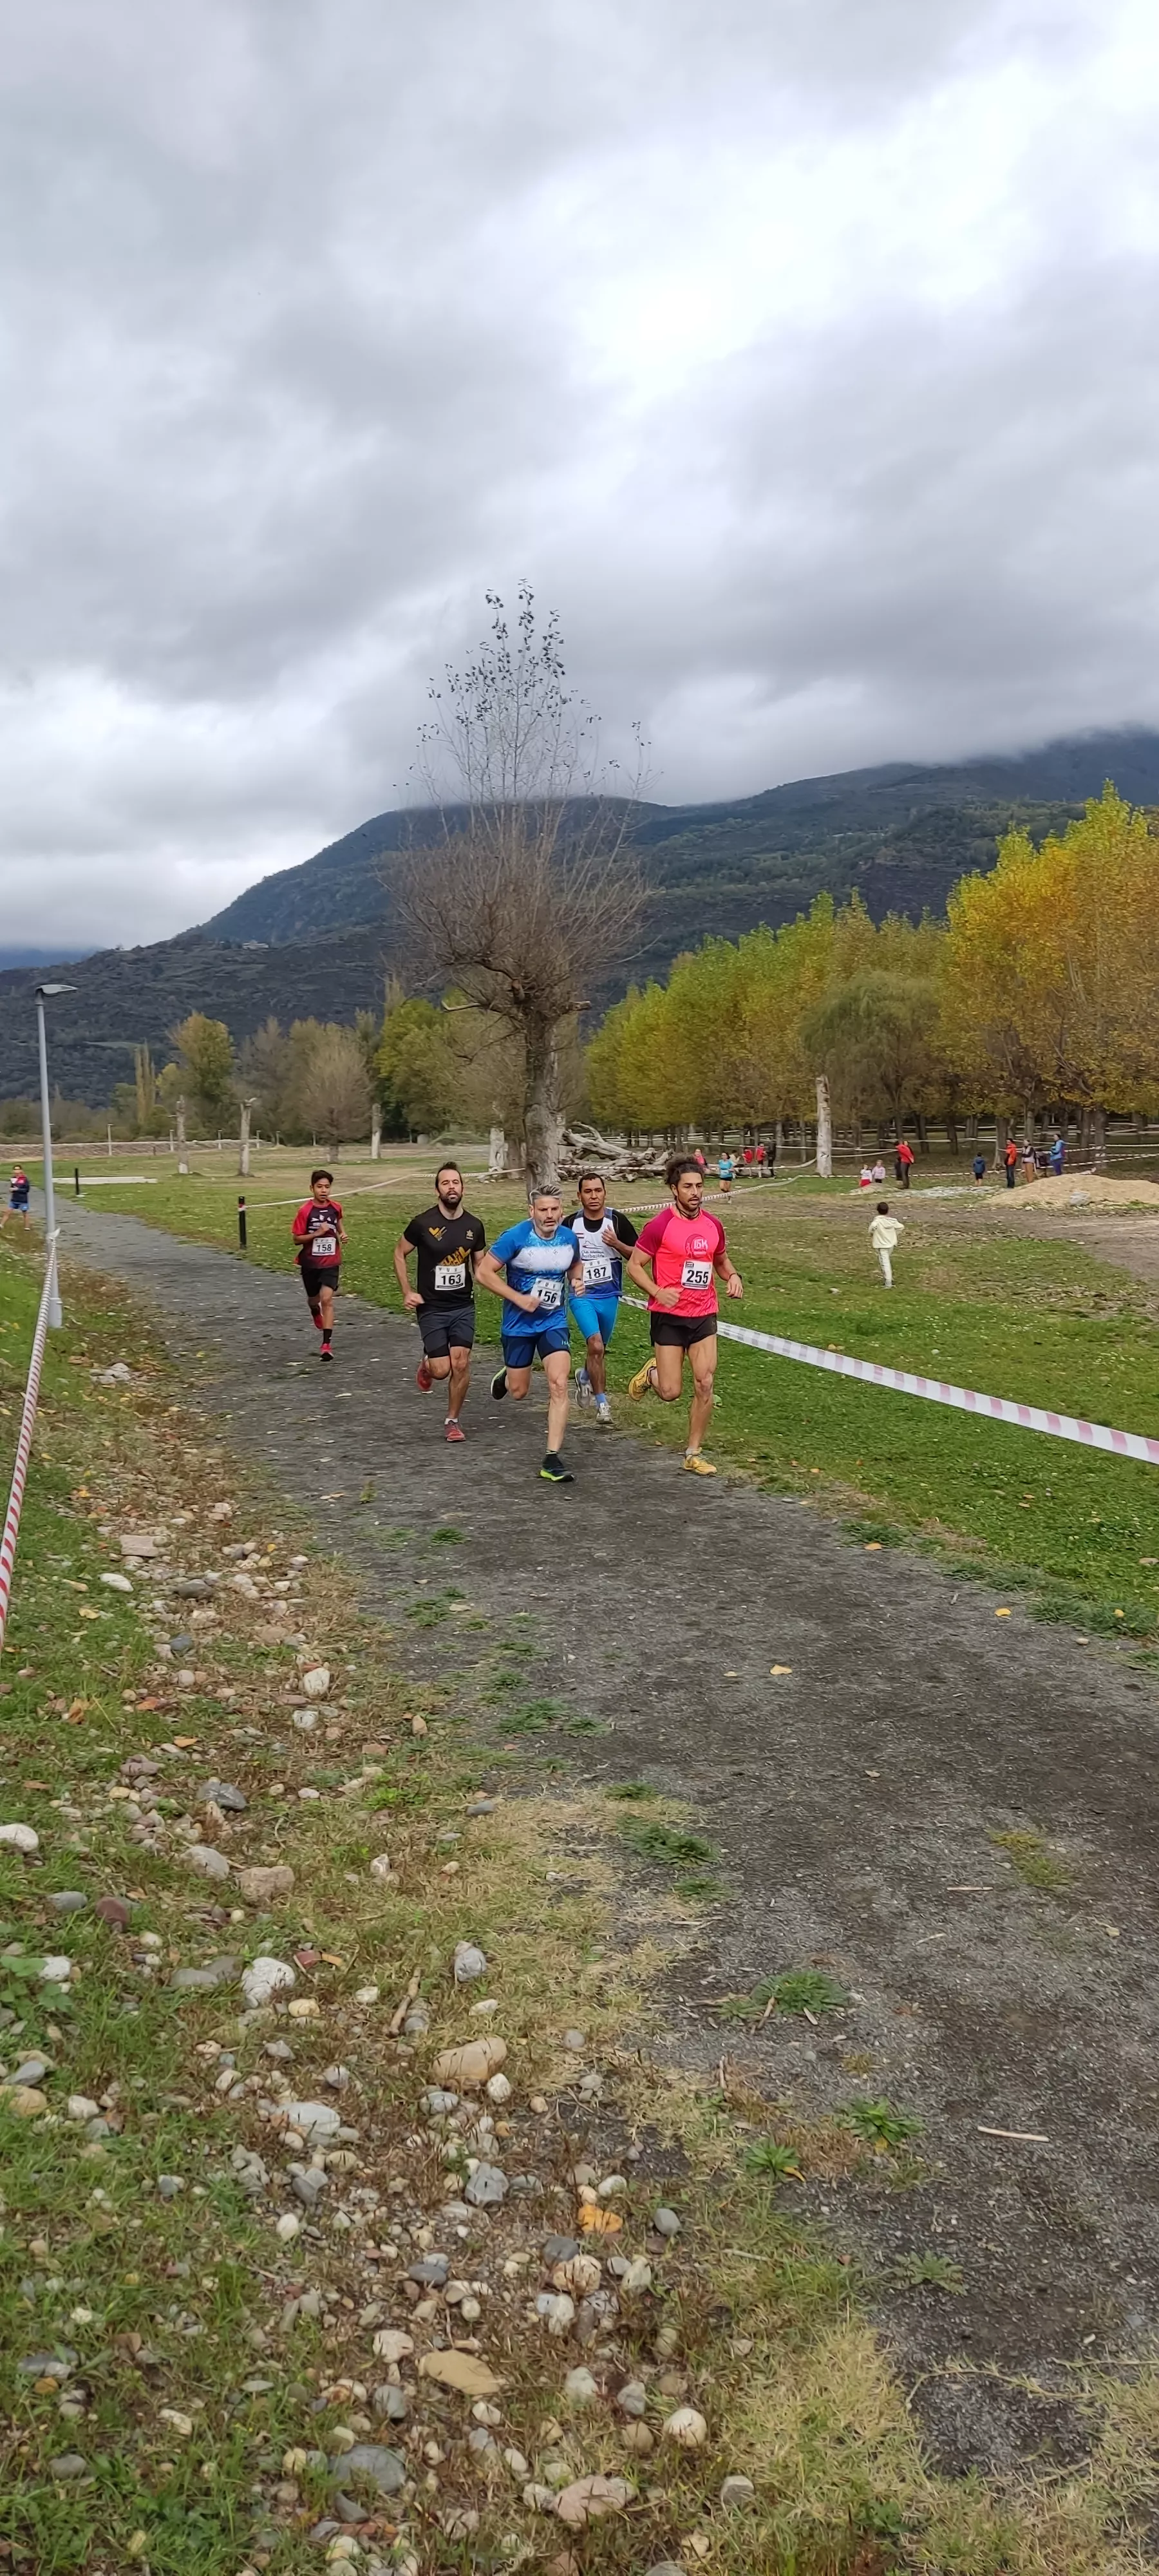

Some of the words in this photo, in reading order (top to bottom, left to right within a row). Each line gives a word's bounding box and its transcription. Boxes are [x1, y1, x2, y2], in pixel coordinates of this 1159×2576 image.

[316, 1244, 332, 1252] 158
[440, 1274, 462, 1285] 163
[586, 1266, 607, 1280] 187
[686, 1269, 709, 1284] 255
[537, 1289, 558, 1304] 156
